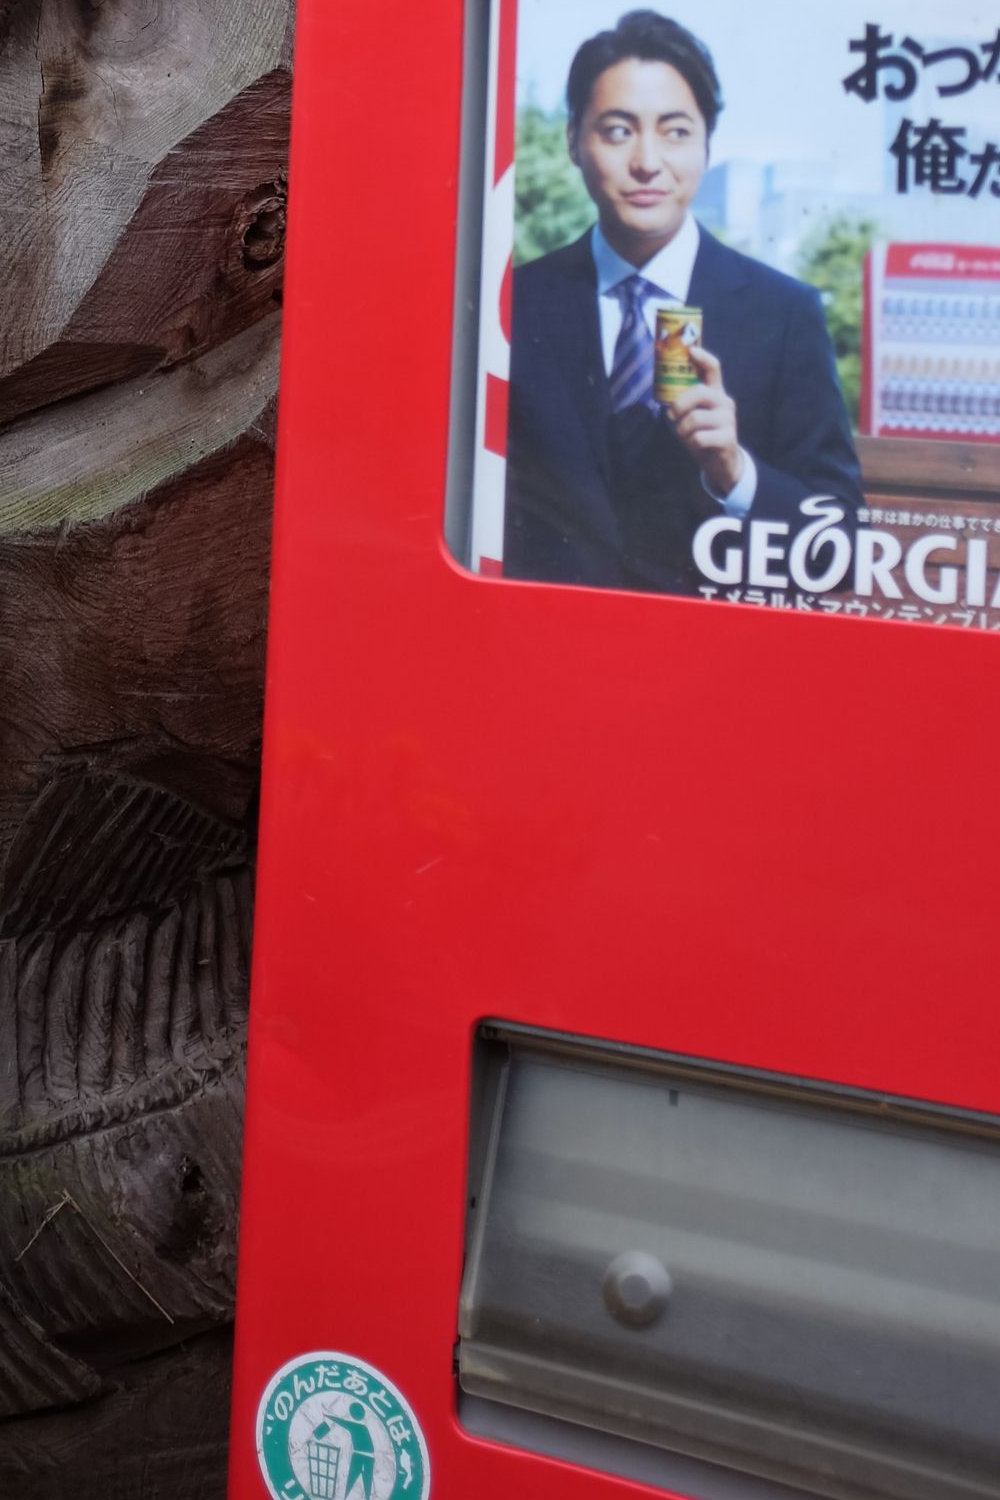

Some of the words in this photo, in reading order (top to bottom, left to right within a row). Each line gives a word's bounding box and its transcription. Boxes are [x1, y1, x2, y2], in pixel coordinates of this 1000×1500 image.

[692, 495, 1000, 608] GEORGI
[274, 1364, 411, 1446] のんだあとは
